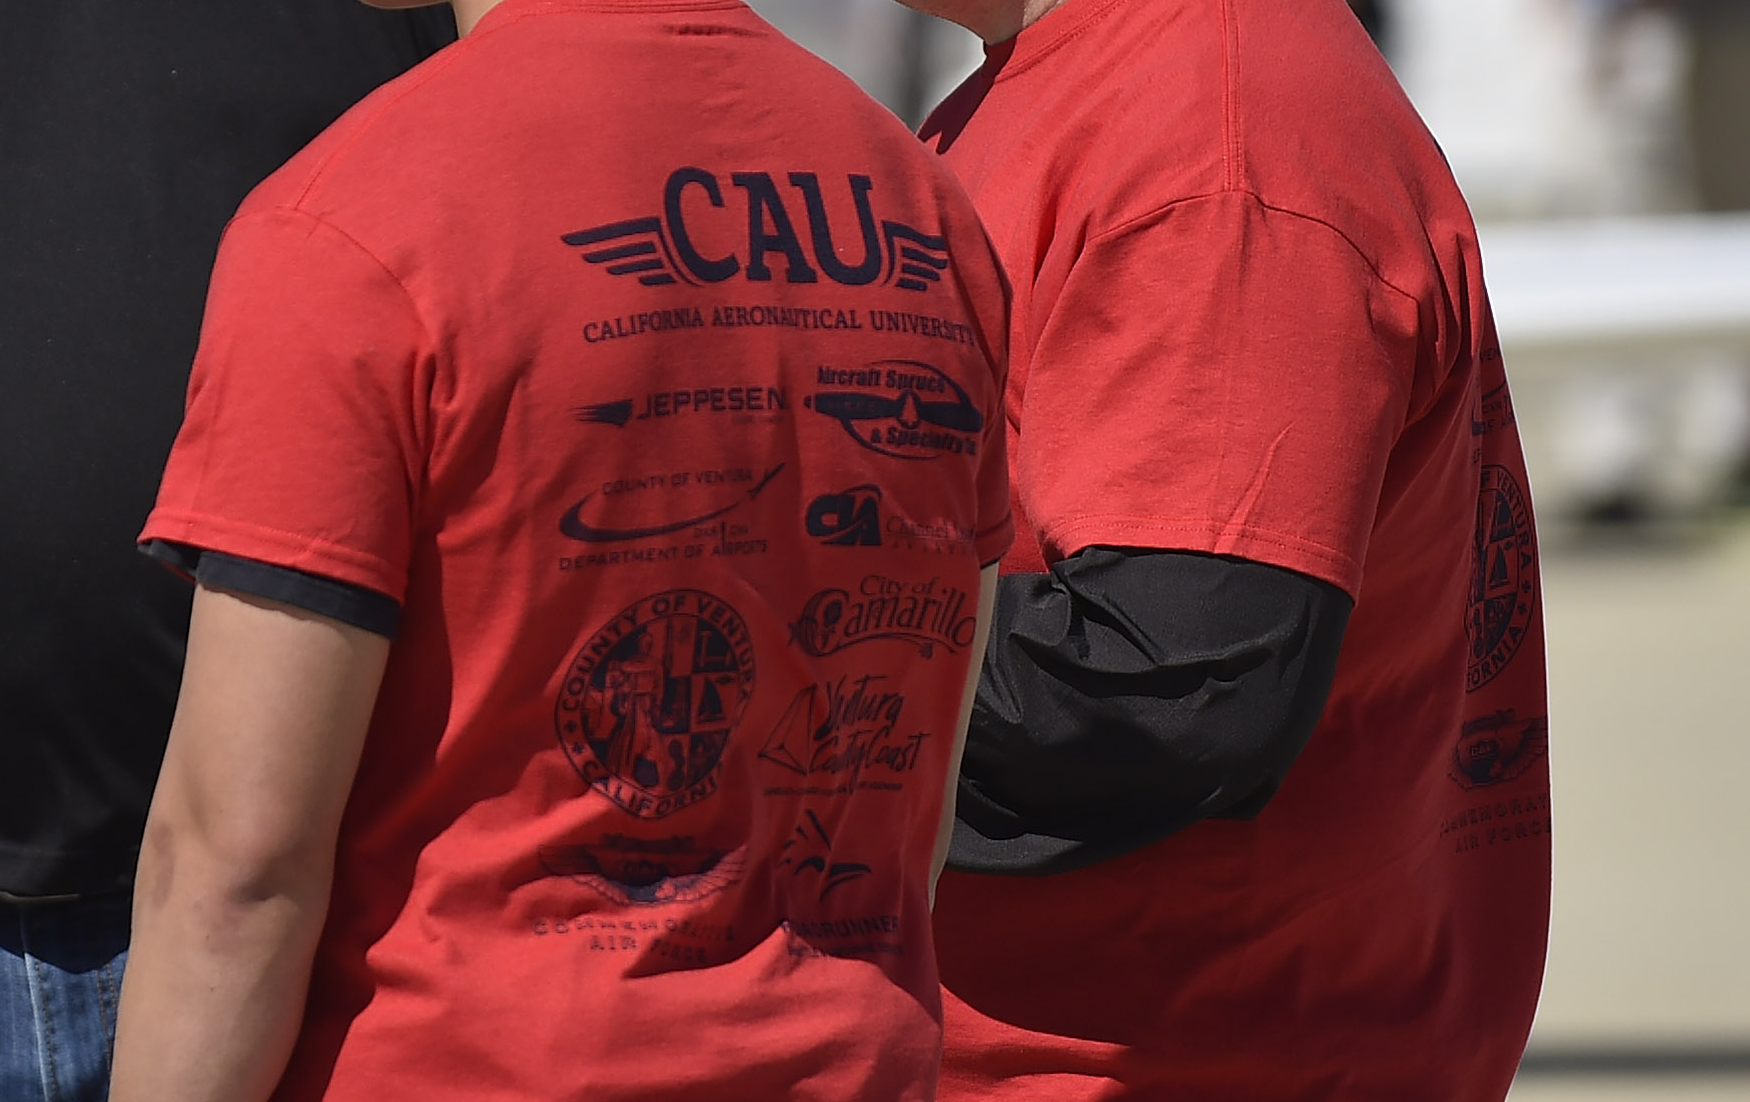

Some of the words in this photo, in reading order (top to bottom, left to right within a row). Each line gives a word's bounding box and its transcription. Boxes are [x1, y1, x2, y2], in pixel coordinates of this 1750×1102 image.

[664, 166, 882, 285] CAU
[582, 307, 704, 343] CALIFORNIA
[711, 304, 863, 331] AERONAUTICAL
[869, 310, 977, 348] UNIVERSITY
[637, 386, 788, 419] JEPPESEN
[817, 364, 882, 386] Aircraft
[886, 369, 946, 394] Spruce
[1497, 470, 1532, 571] VENTURA
[559, 547, 679, 571] DEPARTMENT
[683, 544, 706, 559] OF
[860, 574, 903, 596] City
[910, 575, 943, 595] of
[790, 585, 977, 658] Camarillo
[560, 608, 639, 712] COUNTY
[653, 595, 687, 616] OF
[583, 758, 716, 816] CALIFORNI
